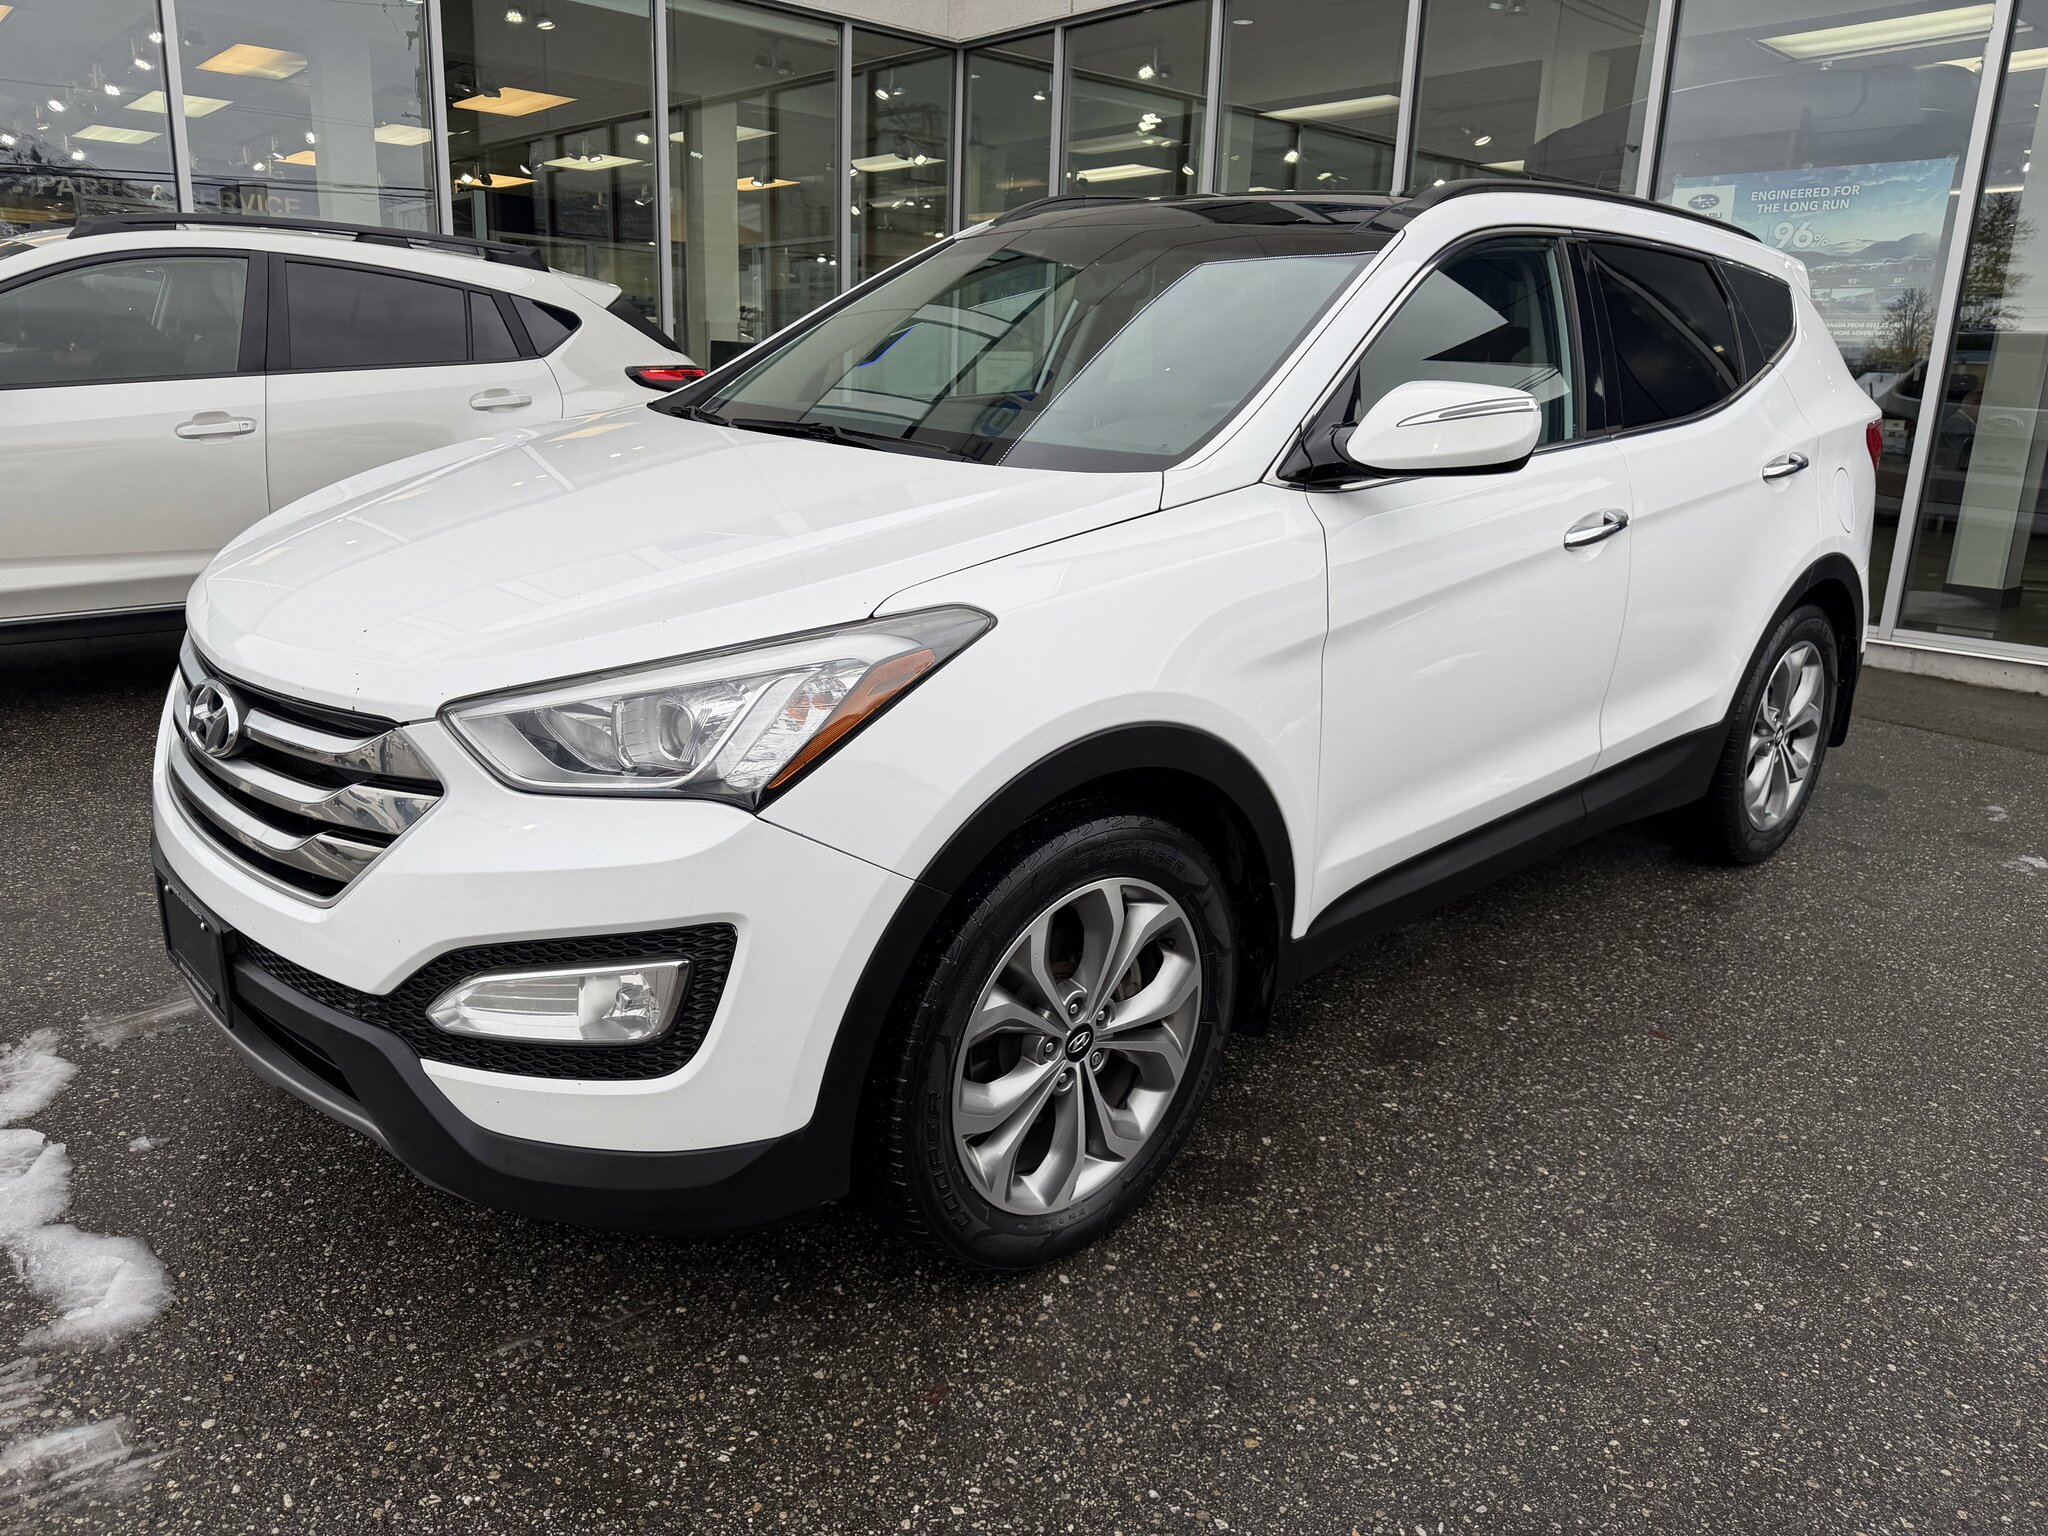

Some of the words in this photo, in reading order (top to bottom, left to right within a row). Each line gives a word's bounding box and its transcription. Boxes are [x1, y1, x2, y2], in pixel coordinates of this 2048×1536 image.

[193, 186, 300, 213] ERVICE
[1750, 187, 1830, 201] ENGINEERED
[1833, 184, 1861, 197] FOR
[1757, 203, 1780, 214] THE
[1783, 200, 1819, 213] LONG
[1822, 198, 1850, 211] RUN
[1773, 221, 1829, 249] 96%
